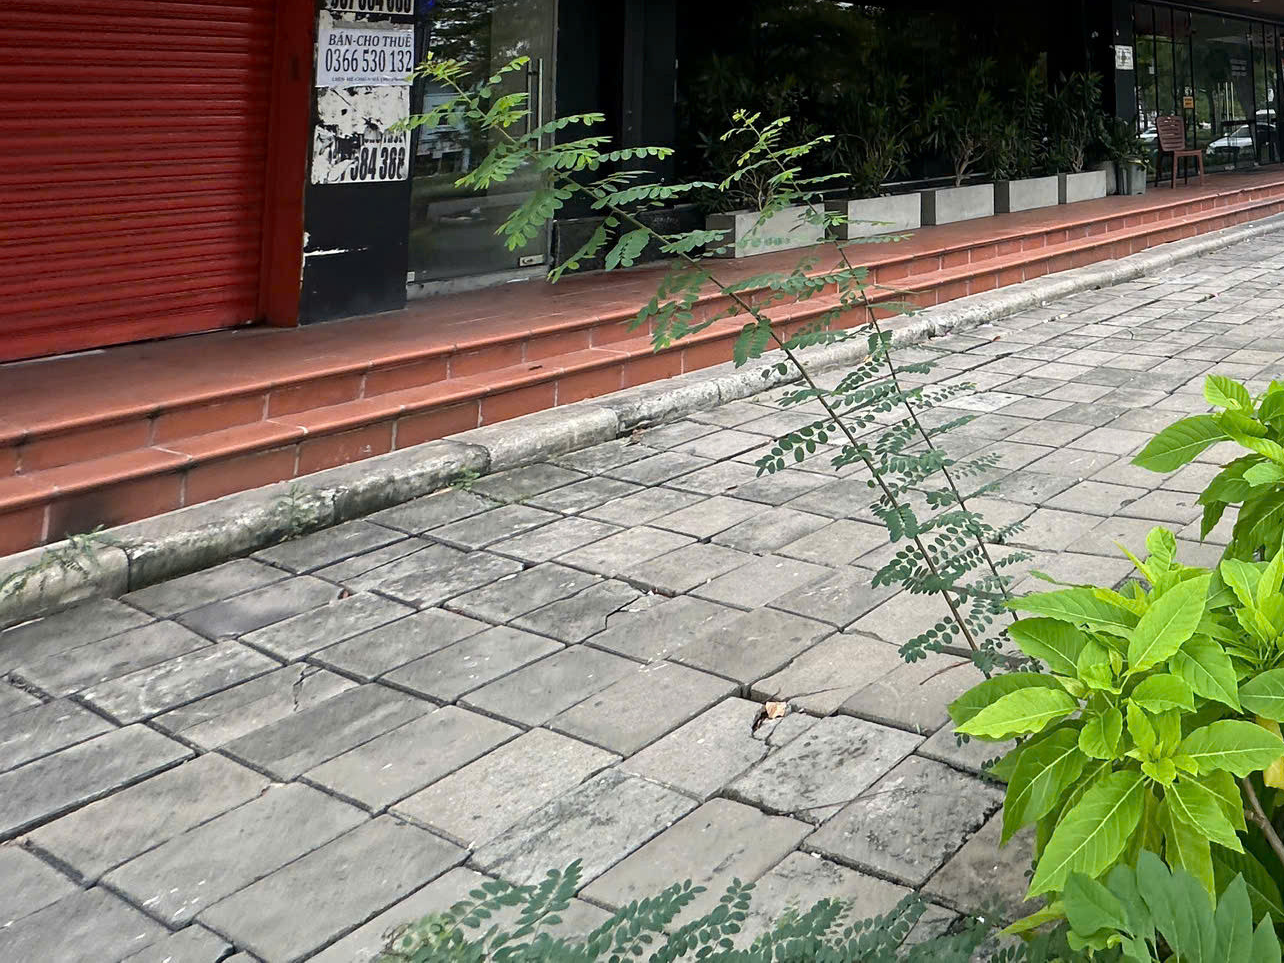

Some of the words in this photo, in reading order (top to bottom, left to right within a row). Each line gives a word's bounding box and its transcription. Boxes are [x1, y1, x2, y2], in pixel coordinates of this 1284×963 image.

[328, 31, 380, 47] BÁN-CHO
[382, 33, 412, 48] THUÊ
[325, 48, 358, 72] 0366
[362, 49, 386, 72] 530
[390, 50, 412, 72] 132
